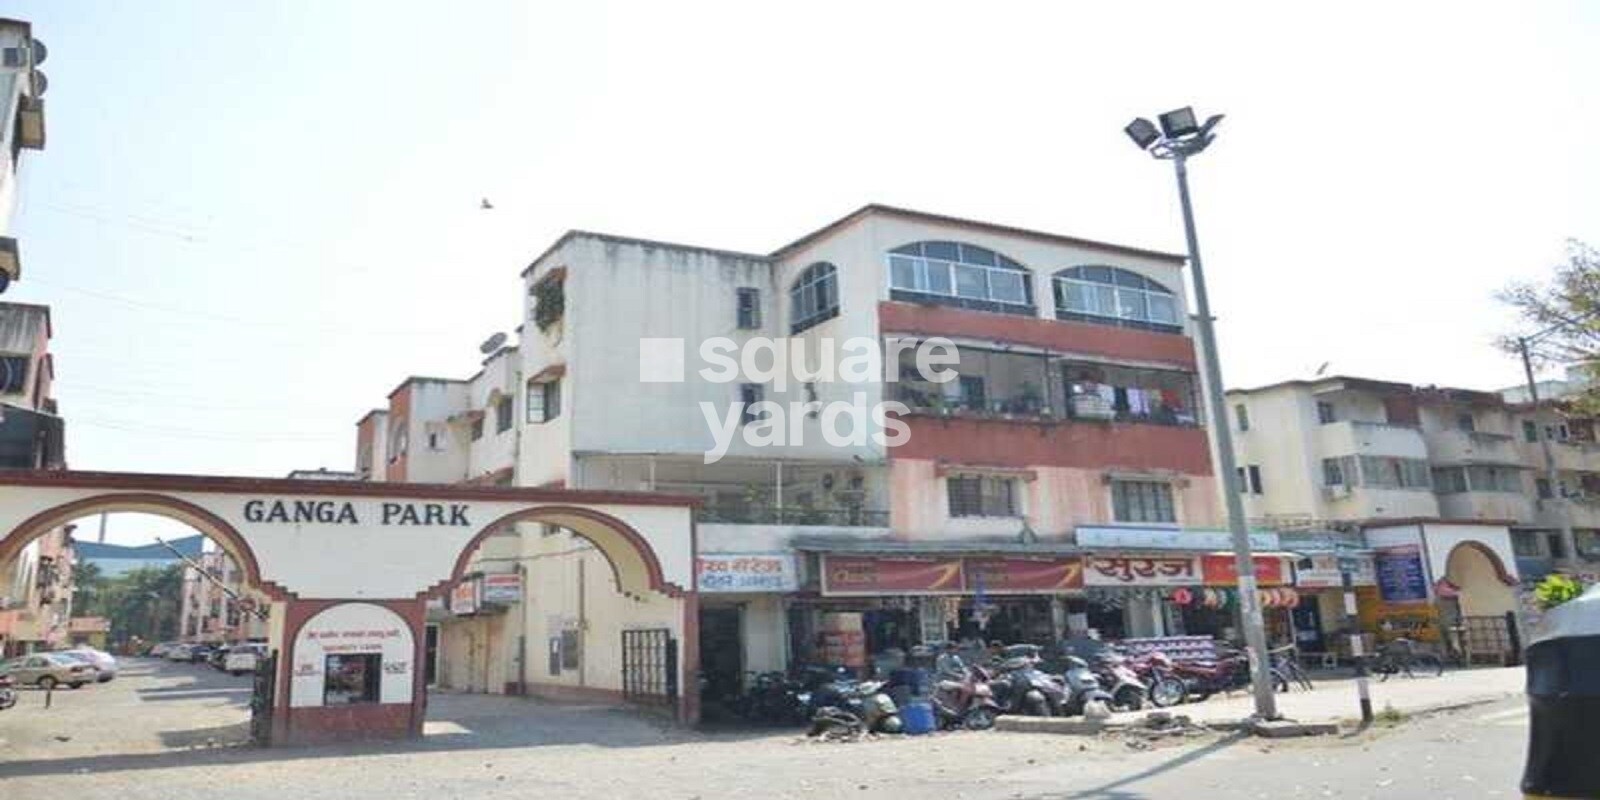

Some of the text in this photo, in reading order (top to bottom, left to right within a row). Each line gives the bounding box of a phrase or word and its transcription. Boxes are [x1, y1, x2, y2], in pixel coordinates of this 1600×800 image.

[243, 499, 471, 527] GANGA PARK
[1093, 556, 1194, 581] सुरज
